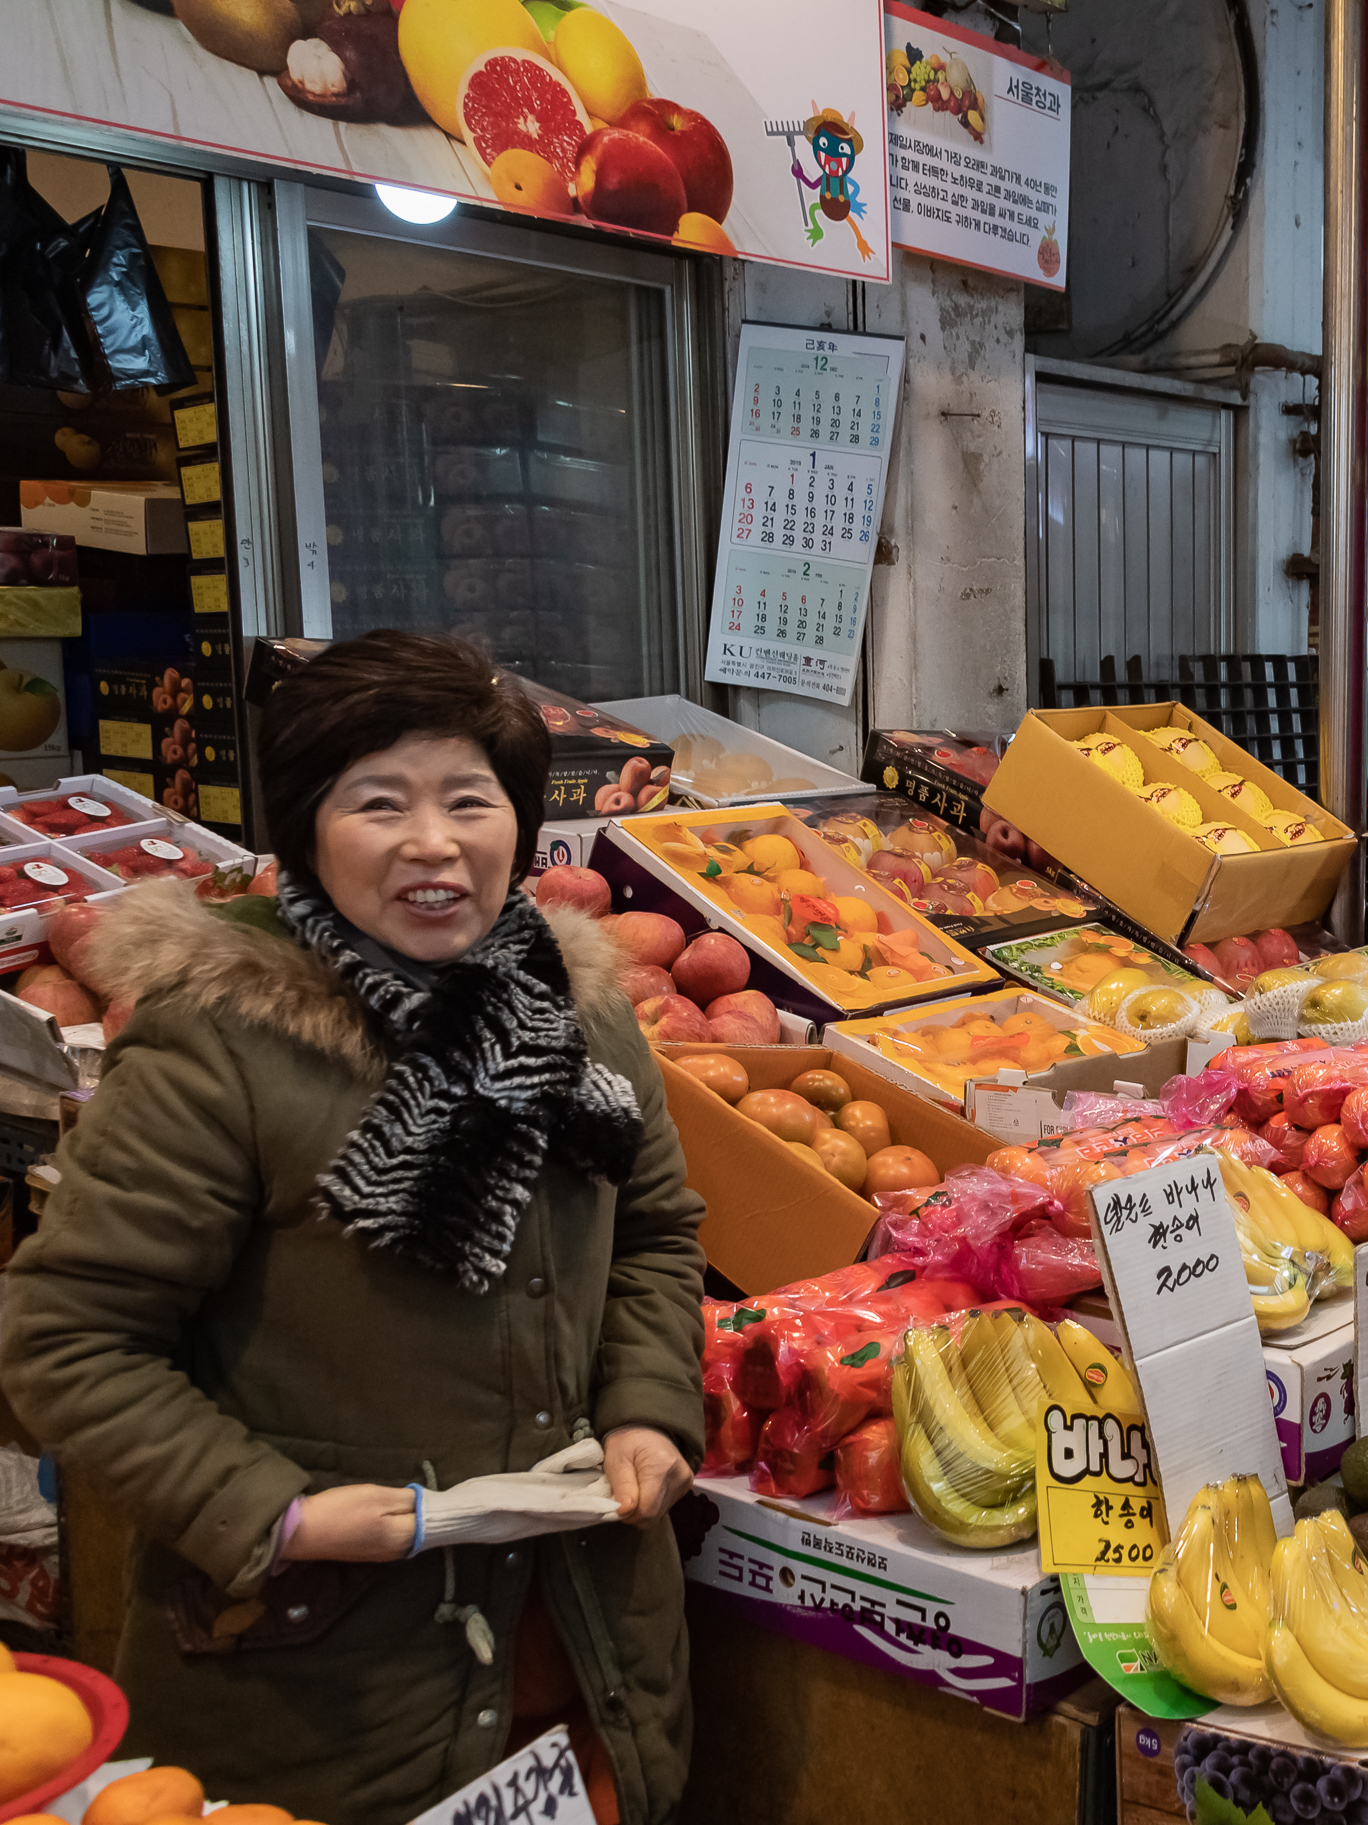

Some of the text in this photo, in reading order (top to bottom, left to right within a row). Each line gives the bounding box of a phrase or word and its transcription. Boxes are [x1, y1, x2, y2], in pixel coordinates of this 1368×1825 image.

[1006, 75, 1061, 116] 서울청과
[888, 132, 943, 161] 제일시장에서
[944, 149, 962, 168] 가장
[963, 156, 989, 175] 오래된
[1023, 177, 1043, 194] 40년
[1043, 182, 1058, 198] 동안
[900, 156, 920, 174] 함께
[921, 162, 949, 182] 터득한
[950, 171, 984, 193] 노하우로
[985, 182, 1002, 199] 고른
[1002, 188, 1035, 208] 과일에는
[913, 181, 949, 203] 싱싱하고
[950, 191, 968, 208] 실한
[970, 197, 996, 217] 과일을
[997, 205, 1015, 222] 싸게
[916, 203, 953, 224] 이바지도
[955, 213, 981, 233] 귀하게
[982, 223, 1032, 248] 다루겠습니다.
[805, 338, 838, 353] 己亥年
[813, 355, 829, 371] 12
[754, 383, 840, 403] 2 3 4 5 6
[876, 384, 880, 394] 1
[809, 450, 817, 470] 1
[745, 482, 874, 512] 6 7 8 9 10 11 12
[790, 473, 873, 496] 1 2 3 4 5
[741, 497, 872, 527] 13 14 15 16 17 18 19
[736, 527, 832, 553] 27 28 29 30 31
[738, 512, 870, 543] 20 21 22 23 24 25 26
[802, 561, 811, 577] 2
[736, 585, 857, 614] 3 4 5 6 7 8 9
[839, 589, 859, 602] 1 2
[722, 642, 753, 659] KU
[753, 671, 798, 686] 447-7005
[549, 784, 587, 807] 사과
[1043, 1124, 1055, 1135] FOR
[1162, 1167, 1217, 1209] 바나나
[1156, 1253, 1219, 1296] 2000
[800, 1531, 888, 1572] 보현산포도작목반
[1094, 1538, 1155, 1564] 2500
[717, 1546, 964, 1659] 영천 보현산 포도
[1138, 1733, 1160, 1752] 5kg
